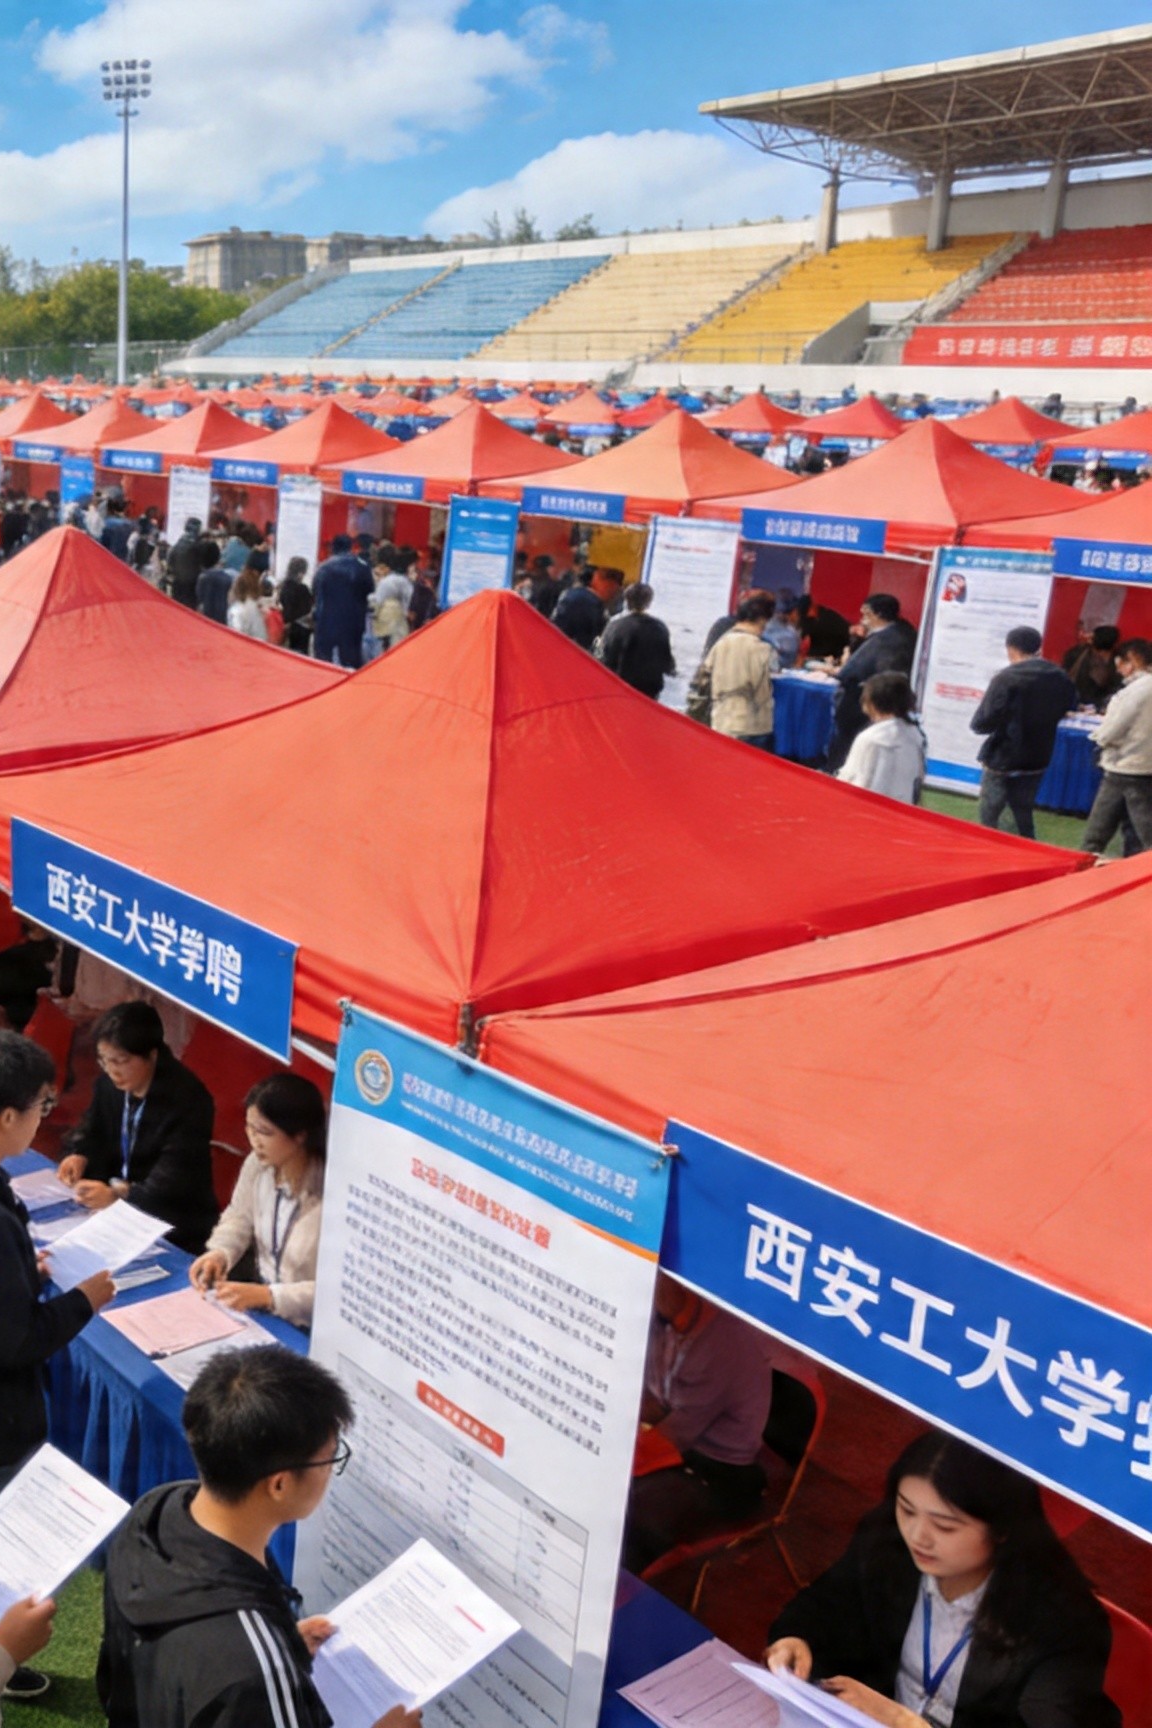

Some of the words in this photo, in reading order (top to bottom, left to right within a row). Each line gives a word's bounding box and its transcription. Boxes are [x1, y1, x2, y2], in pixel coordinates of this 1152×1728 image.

[744, 1203, 1152, 1482] 西安工大学
